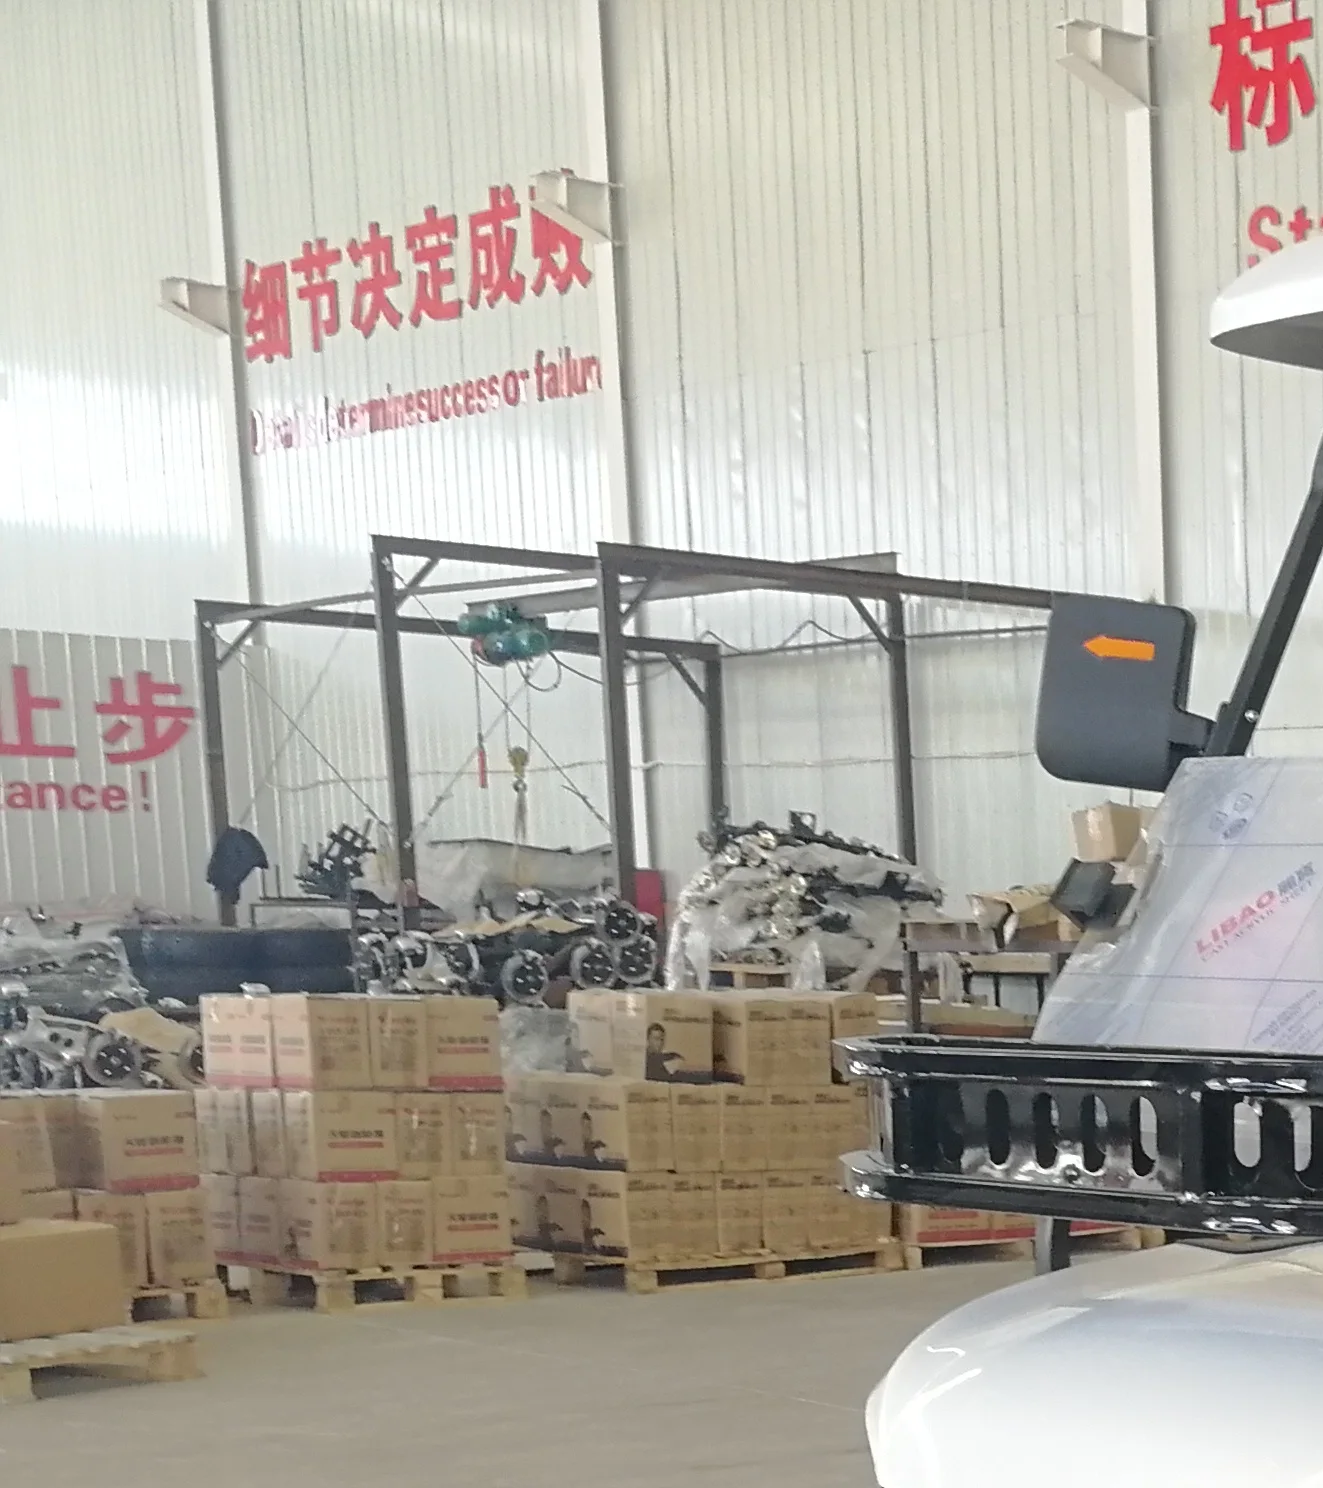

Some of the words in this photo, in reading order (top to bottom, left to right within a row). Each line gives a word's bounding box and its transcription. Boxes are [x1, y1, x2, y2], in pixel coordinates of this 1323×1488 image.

[416, 373, 500, 424] success
[501, 368, 529, 406] or
[533, 345, 603, 403] failur
[1196, 890, 1275, 955] LIBAO
